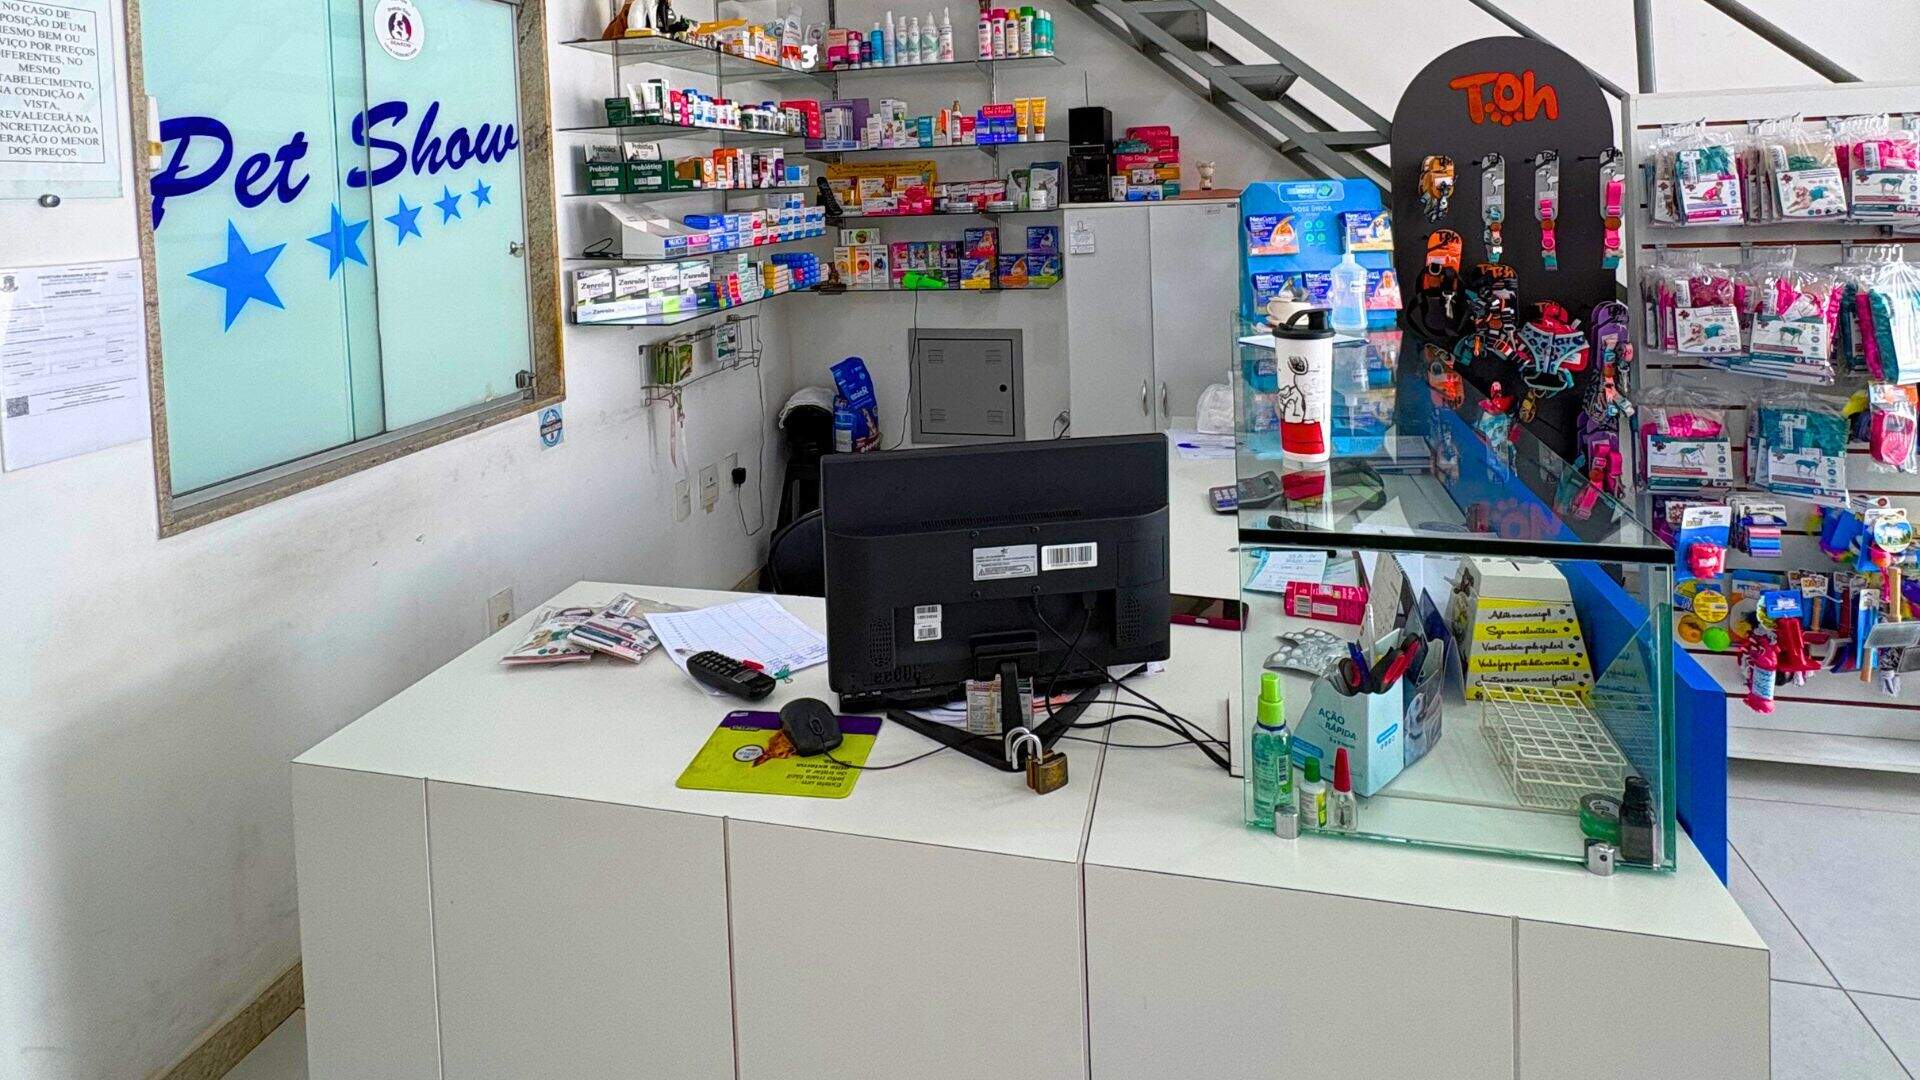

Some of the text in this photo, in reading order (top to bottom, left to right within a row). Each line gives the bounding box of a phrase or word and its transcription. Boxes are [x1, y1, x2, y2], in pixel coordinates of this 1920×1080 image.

[3, 2, 71, 19] NO CASO DE
[52, 20, 67, 30] DE
[69, 23, 87, 33] UM
[0, 25, 80, 43] ESMO BEM OU
[30, 41, 52, 51] POR
[55, 43, 96, 57] PREÇOS
[67, 57, 83, 66] NO
[18, 63, 60, 75] MESMO
[15, 86, 75, 99] CONDIÇÃO
[75, 113, 91, 123] NA
[83, 126, 98, 135] DA
[49, 136, 59, 145] O
[61, 137, 99, 146] MENOR
[8, 146, 32, 155] DOS
[150, 101, 519, 231] Pet Show
[1318, 707, 1345, 725] AÇÃO
[1325, 722, 1357, 740] RÁPIDA
